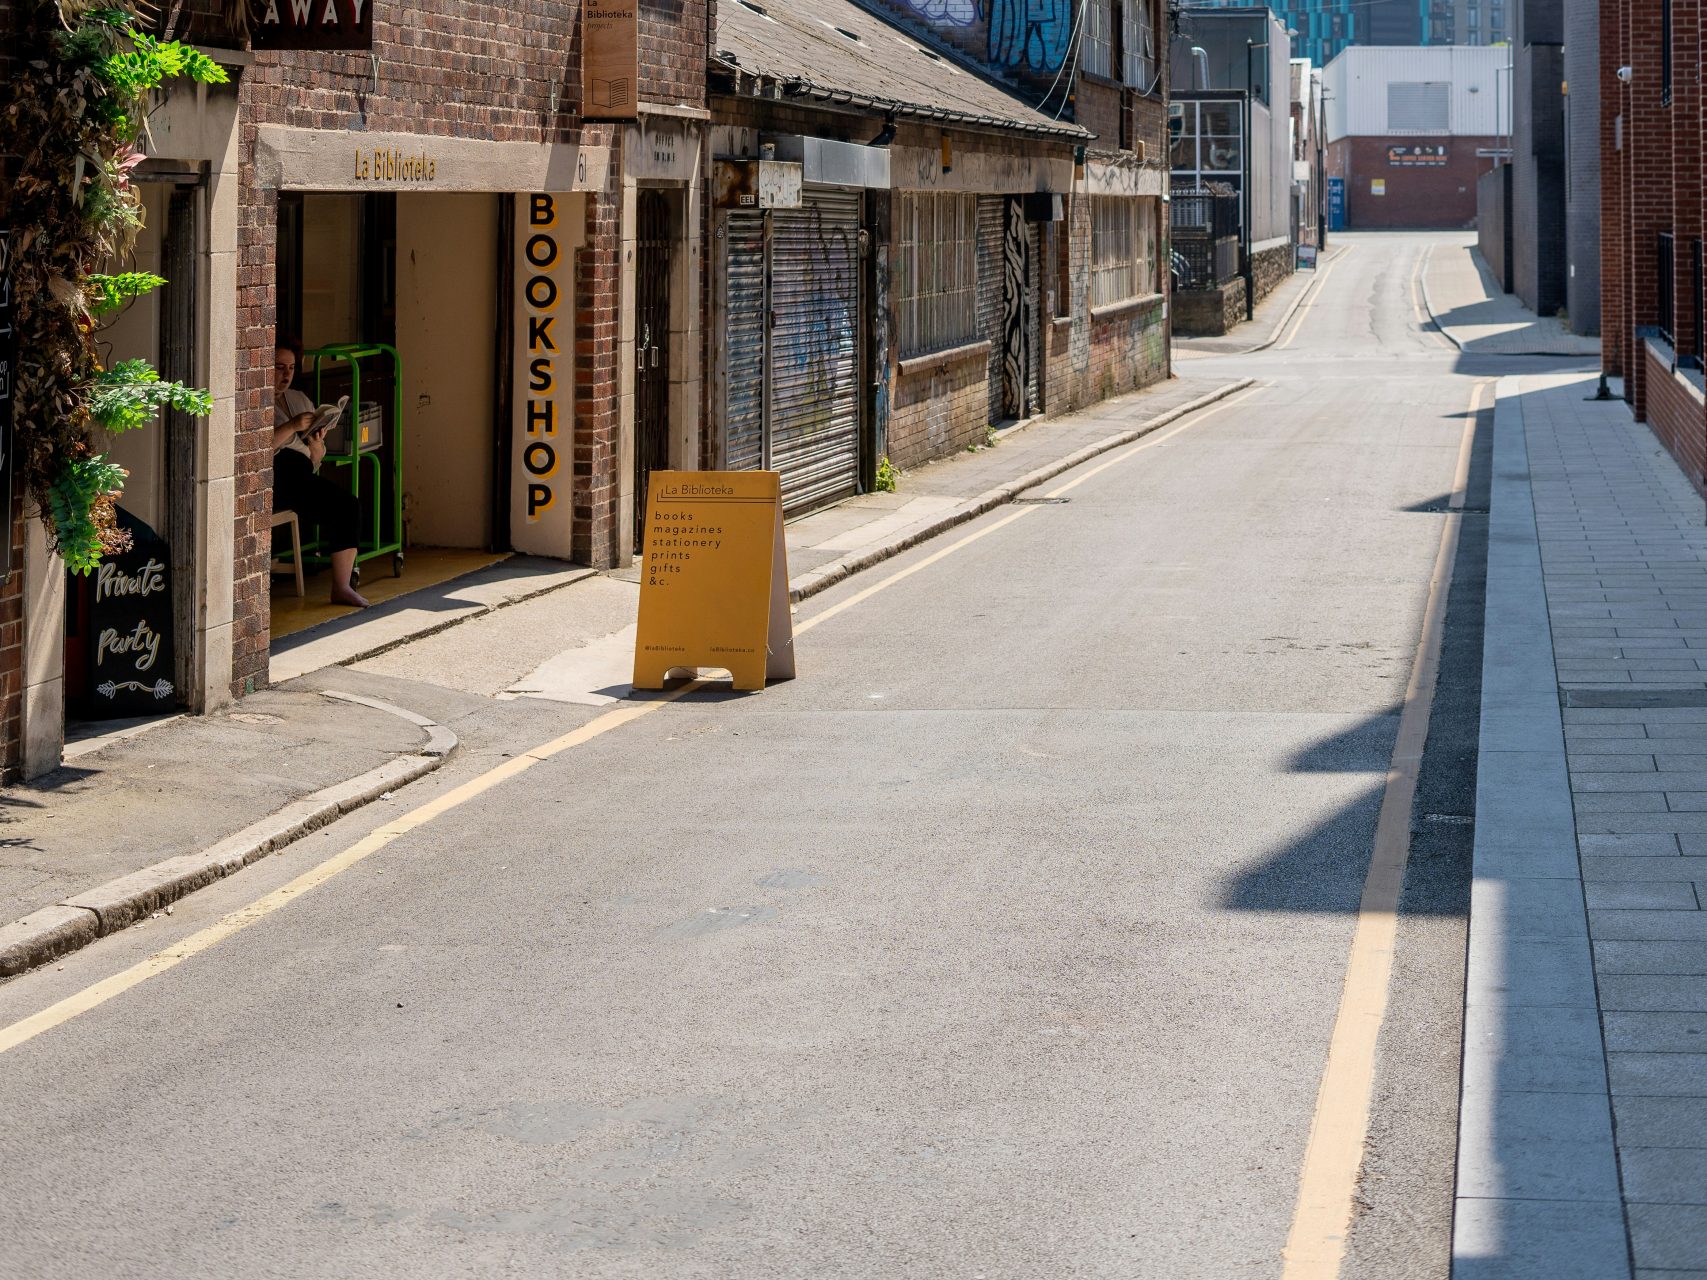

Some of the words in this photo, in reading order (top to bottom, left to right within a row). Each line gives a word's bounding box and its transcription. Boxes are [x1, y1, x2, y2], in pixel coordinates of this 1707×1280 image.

[587, 10, 633, 19] Biblioteka
[355, 147, 369, 180] La
[374, 145, 436, 181] Biblioteka
[523, 193, 561, 521] BOOKSHOP
[665, 484, 678, 495] La
[681, 484, 734, 495] Biblioteka
[655, 511, 693, 521] books
[653, 525, 722, 536] magazines
[652, 538, 721, 550] stationery
[651, 551, 690, 562] prints
[650, 563, 681, 575] gifts
[96, 558, 165, 603] Private
